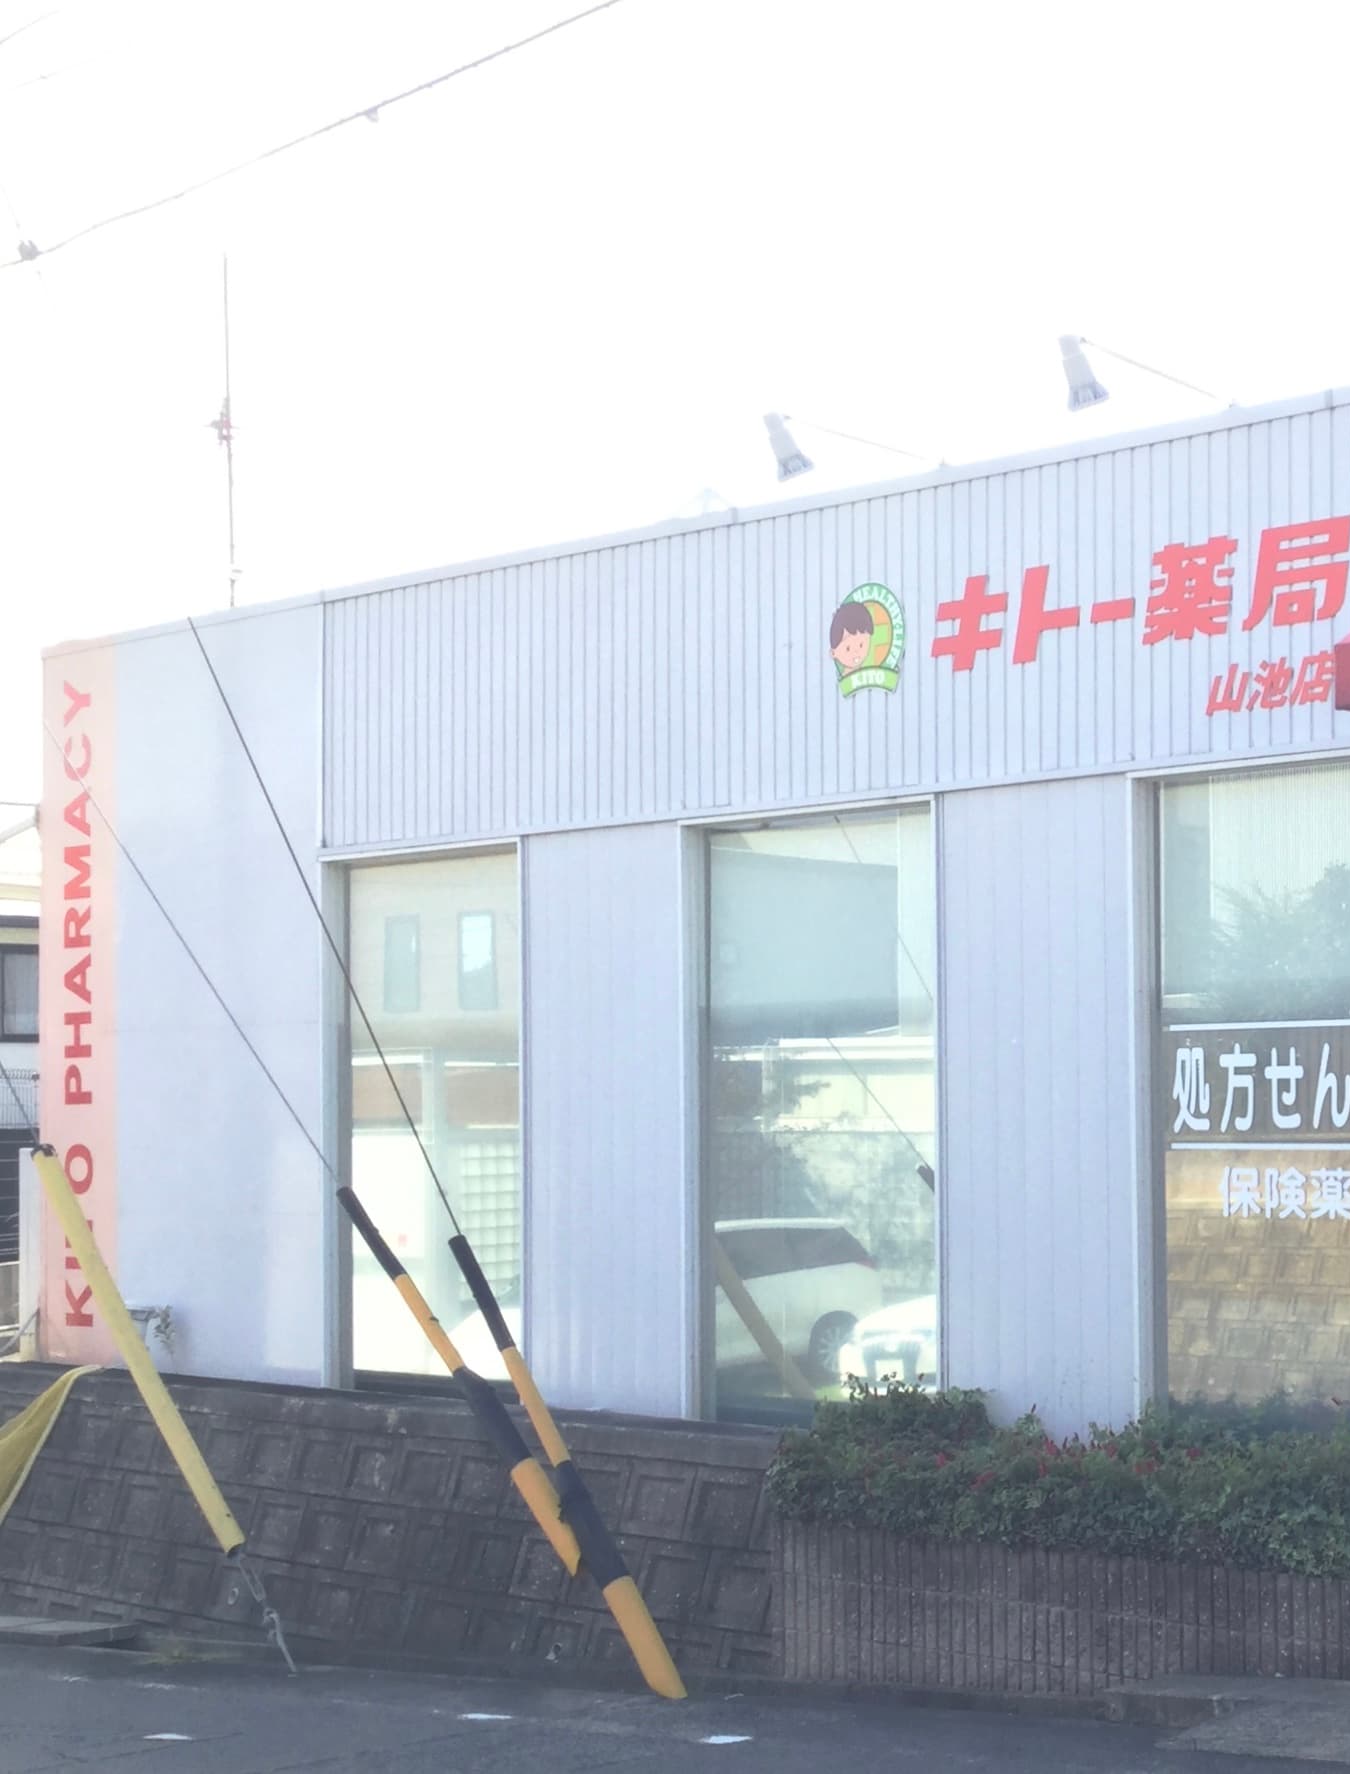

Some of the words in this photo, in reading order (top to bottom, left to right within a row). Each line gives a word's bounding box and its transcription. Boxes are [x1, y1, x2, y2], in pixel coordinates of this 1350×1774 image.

[1206, 650, 1336, 717] 山池店
[64, 681, 94, 1106] PHARMACY
[64, 1143, 94, 1327] KO
